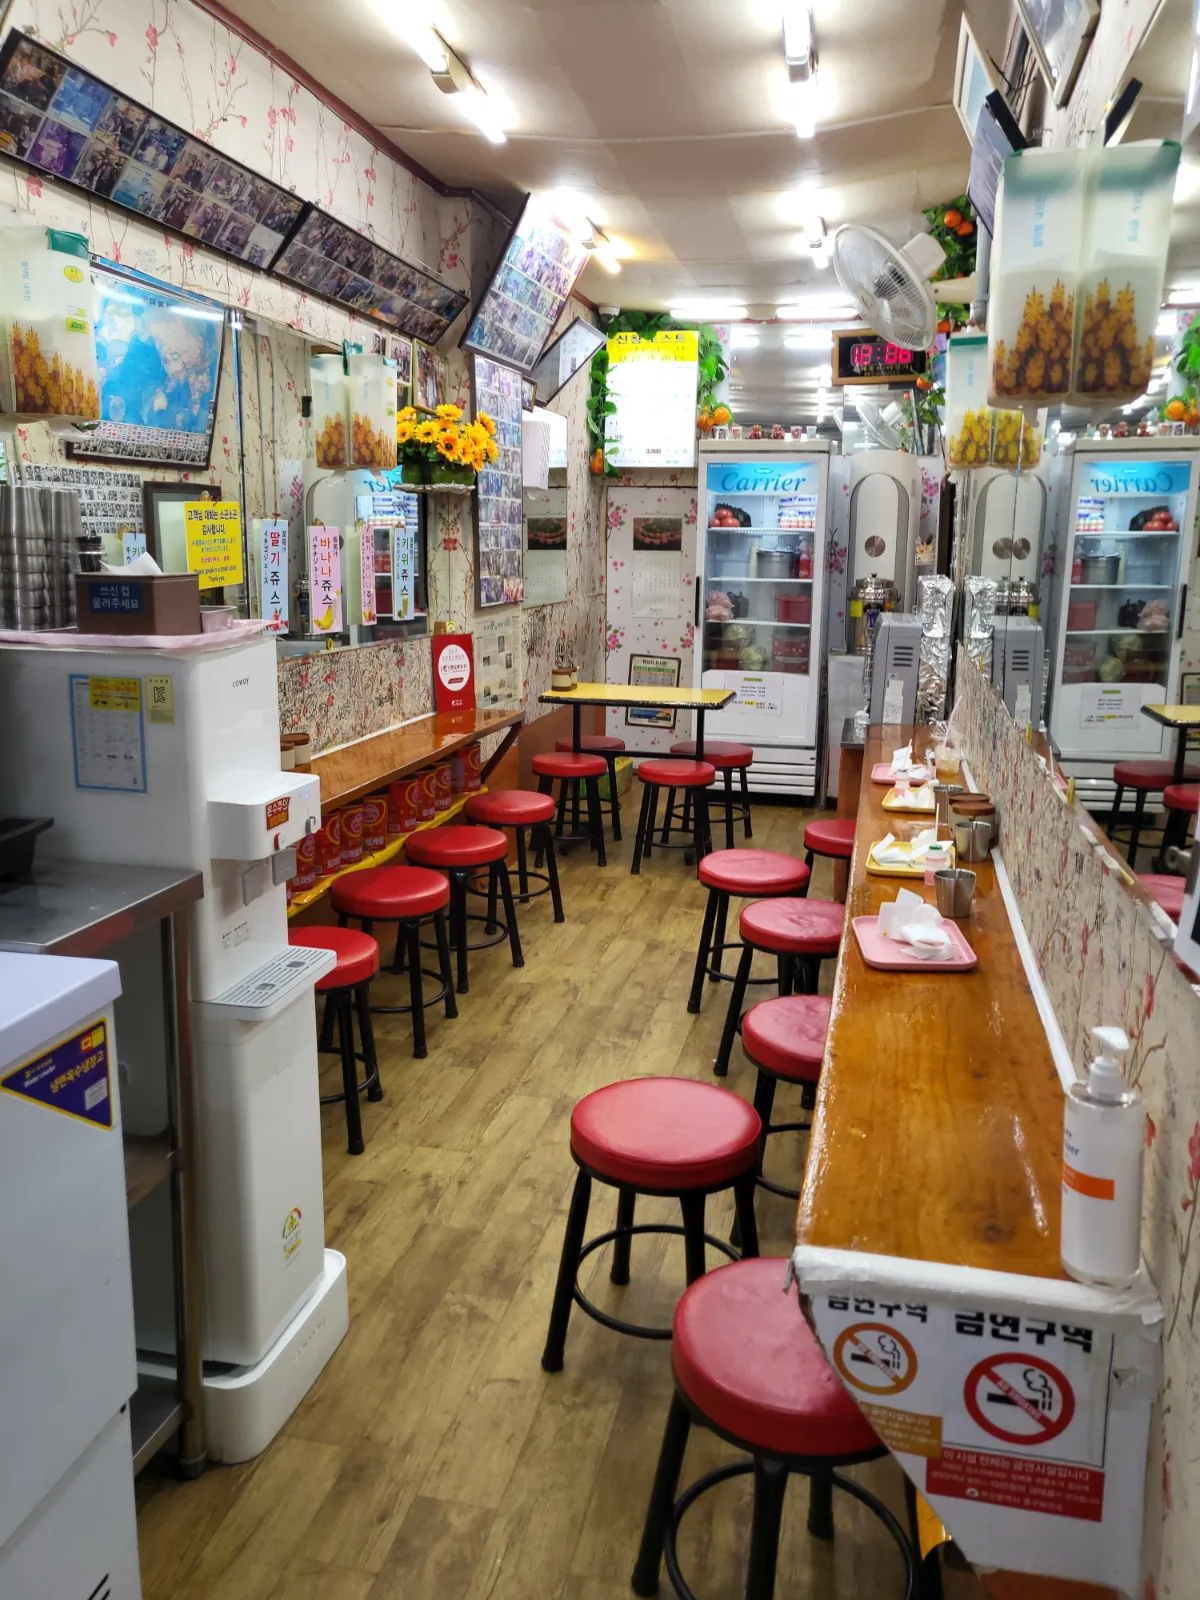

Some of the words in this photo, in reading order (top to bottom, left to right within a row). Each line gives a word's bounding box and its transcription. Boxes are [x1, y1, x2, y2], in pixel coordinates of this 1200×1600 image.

[721, 472, 806, 492] Carrier
[188, 509, 203, 521] 고객님
[270, 531, 280, 605] 딸기쥬스
[320, 537, 333, 605] 바나나쥬스
[401, 537, 409, 595] 키위쥬스
[93, 597, 140, 609] 올려주세요
[100, 585, 119, 597] 쓰신
[121, 585, 130, 597] 컵
[267, 797, 289, 818] 온수주의
[954, 1311, 1094, 1354] 금연구역
[943, 1449, 954, 1460] 이
[956, 1451, 977, 1464] 시설
[979, 1455, 1011, 1469] 전체는
[1013, 1459, 1090, 1482] 금연시설입니다
